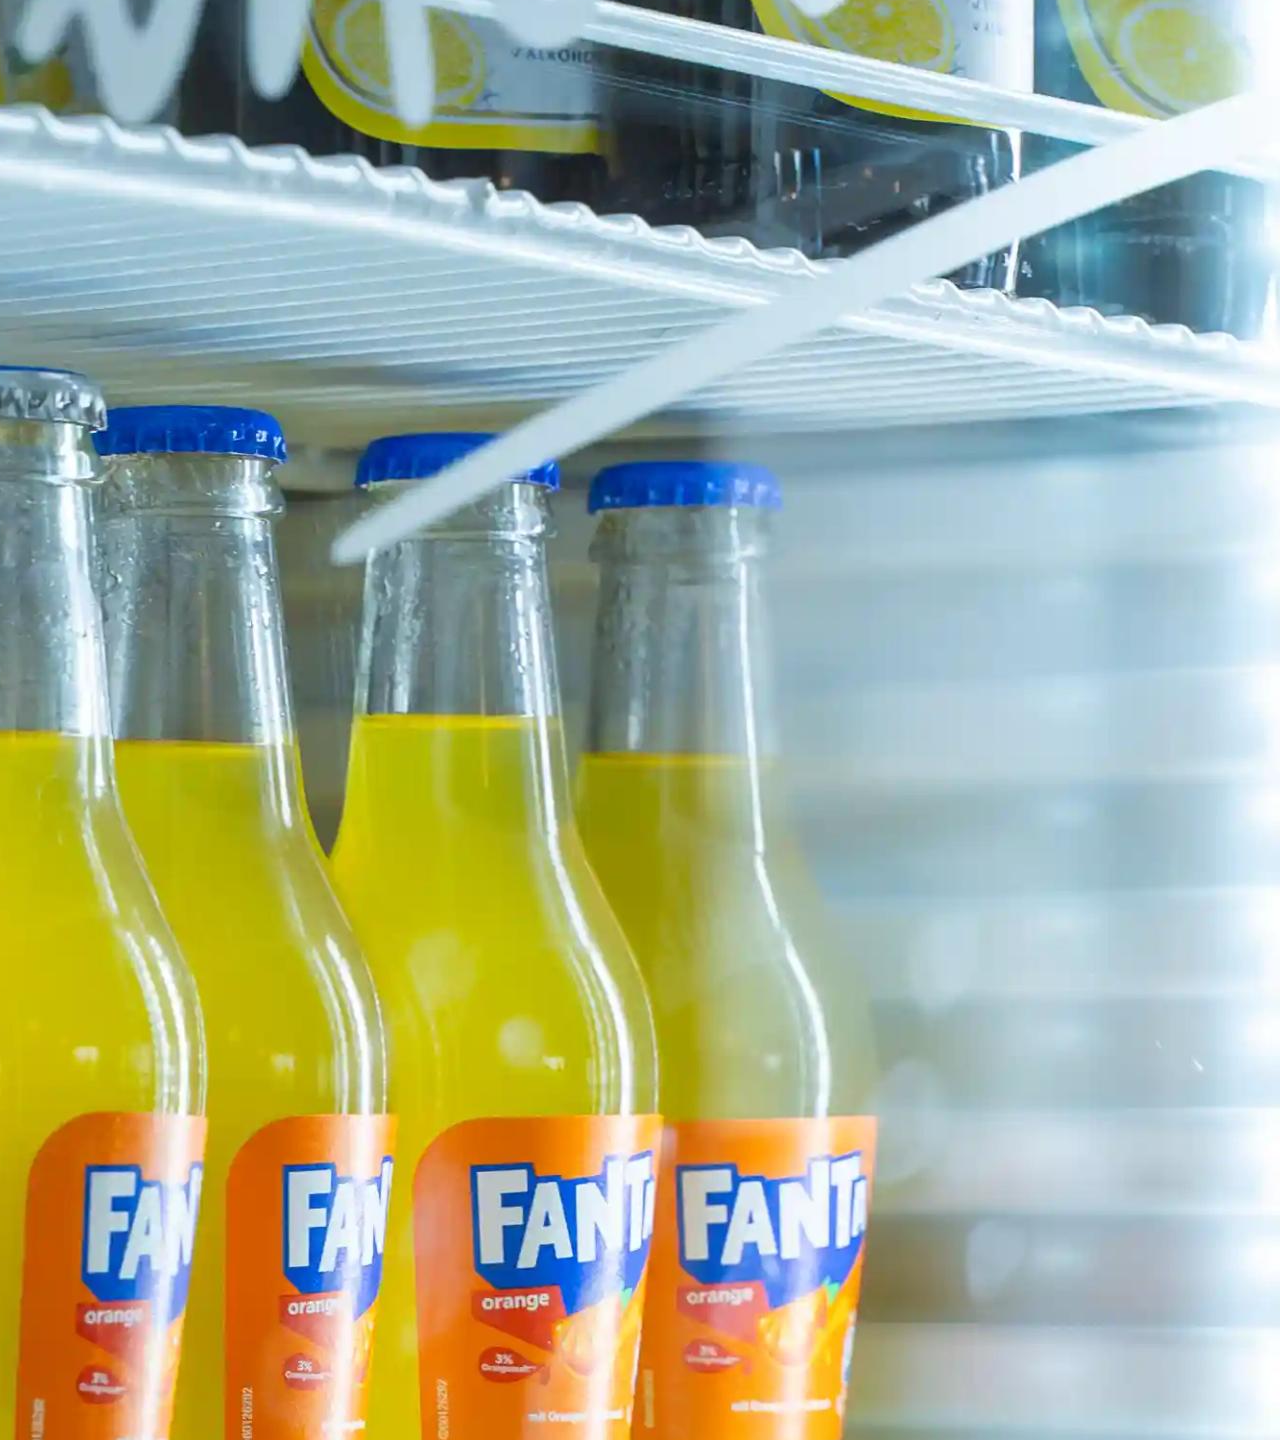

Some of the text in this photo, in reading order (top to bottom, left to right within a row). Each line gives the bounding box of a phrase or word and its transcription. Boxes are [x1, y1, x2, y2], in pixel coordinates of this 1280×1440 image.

[481, 1292, 550, 1312] orange
[685, 1286, 754, 1306] orange
[287, 1298, 344, 1318] orang
